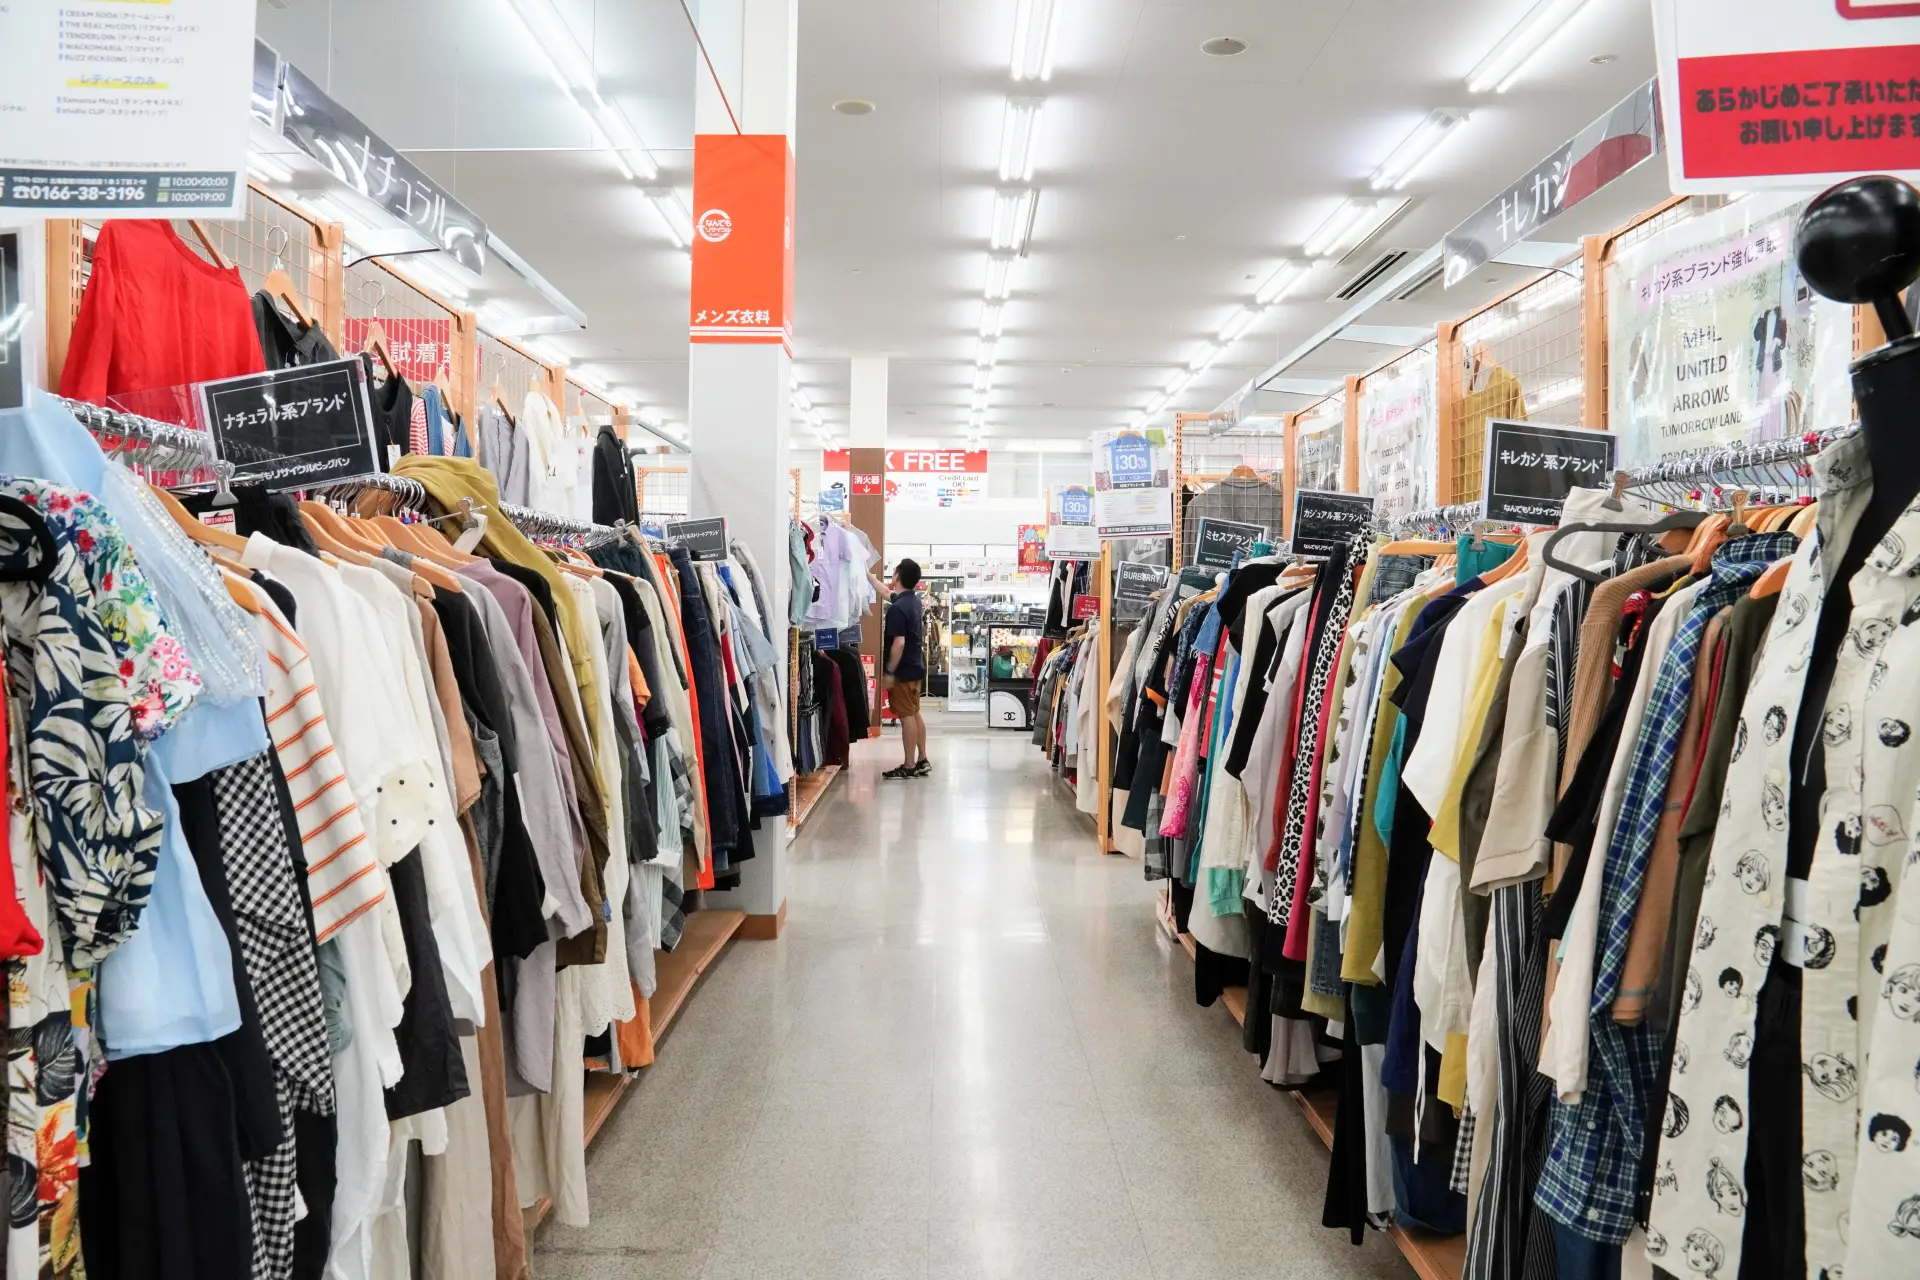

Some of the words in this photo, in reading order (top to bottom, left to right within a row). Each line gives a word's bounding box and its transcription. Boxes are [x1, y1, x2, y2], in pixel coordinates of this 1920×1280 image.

[66, 21, 82, 29] THE
[84, 21, 102, 30] REAL
[81, 74, 156, 86] レディースのみ
[30, 186, 146, 200] 0166-38-3196
[355, 135, 446, 241] ナチュラル
[1496, 151, 1572, 243] キレカジ
[695, 309, 770, 325] メンズ衣料
[1677, 355, 1727, 381] UNITED
[1673, 384, 1730, 412] ARROWS
[223, 392, 348, 430] ナチュラル系ブランド
[262, 457, 350, 480] もリサイクルビッグバン
[904, 452, 965, 471] FREE
[1500, 449, 1603, 473] キレカジ系ブランド
[854, 475, 880, 485] 消火器
[1303, 509, 1367, 523] カジュアル系ブランド
[1123, 571, 1161, 583] BURBERRY
